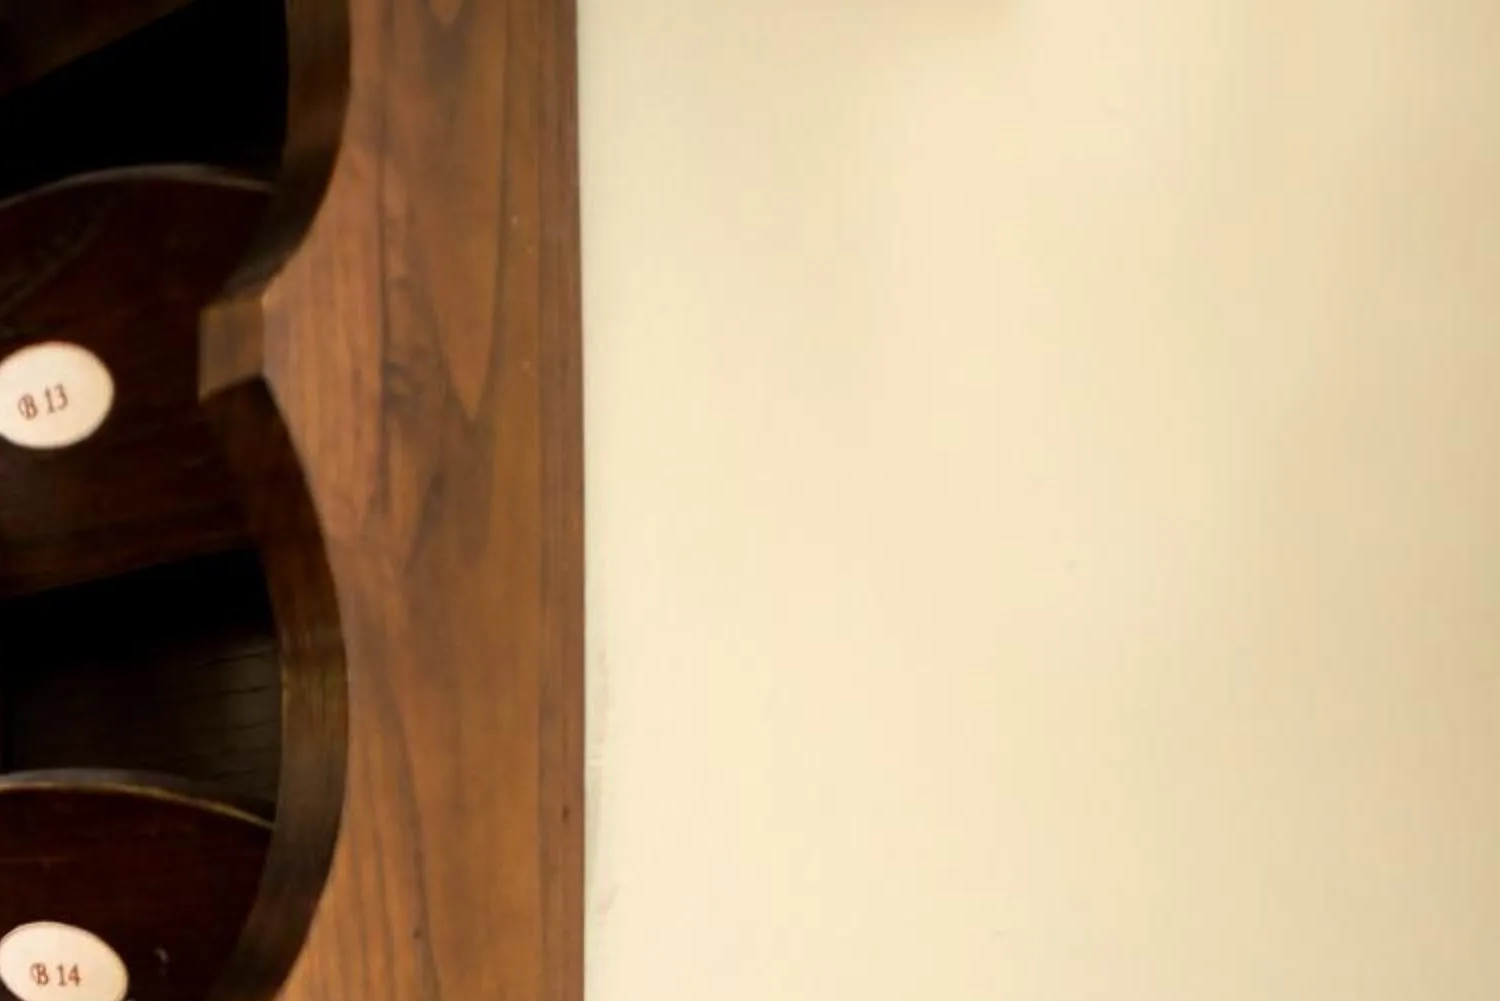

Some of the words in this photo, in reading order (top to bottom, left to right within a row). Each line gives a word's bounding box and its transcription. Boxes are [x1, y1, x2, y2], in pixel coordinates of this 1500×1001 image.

[18, 393, 39, 420] B
[45, 383, 68, 413] 13
[30, 962, 49, 986] B
[57, 963, 81, 987] 14
